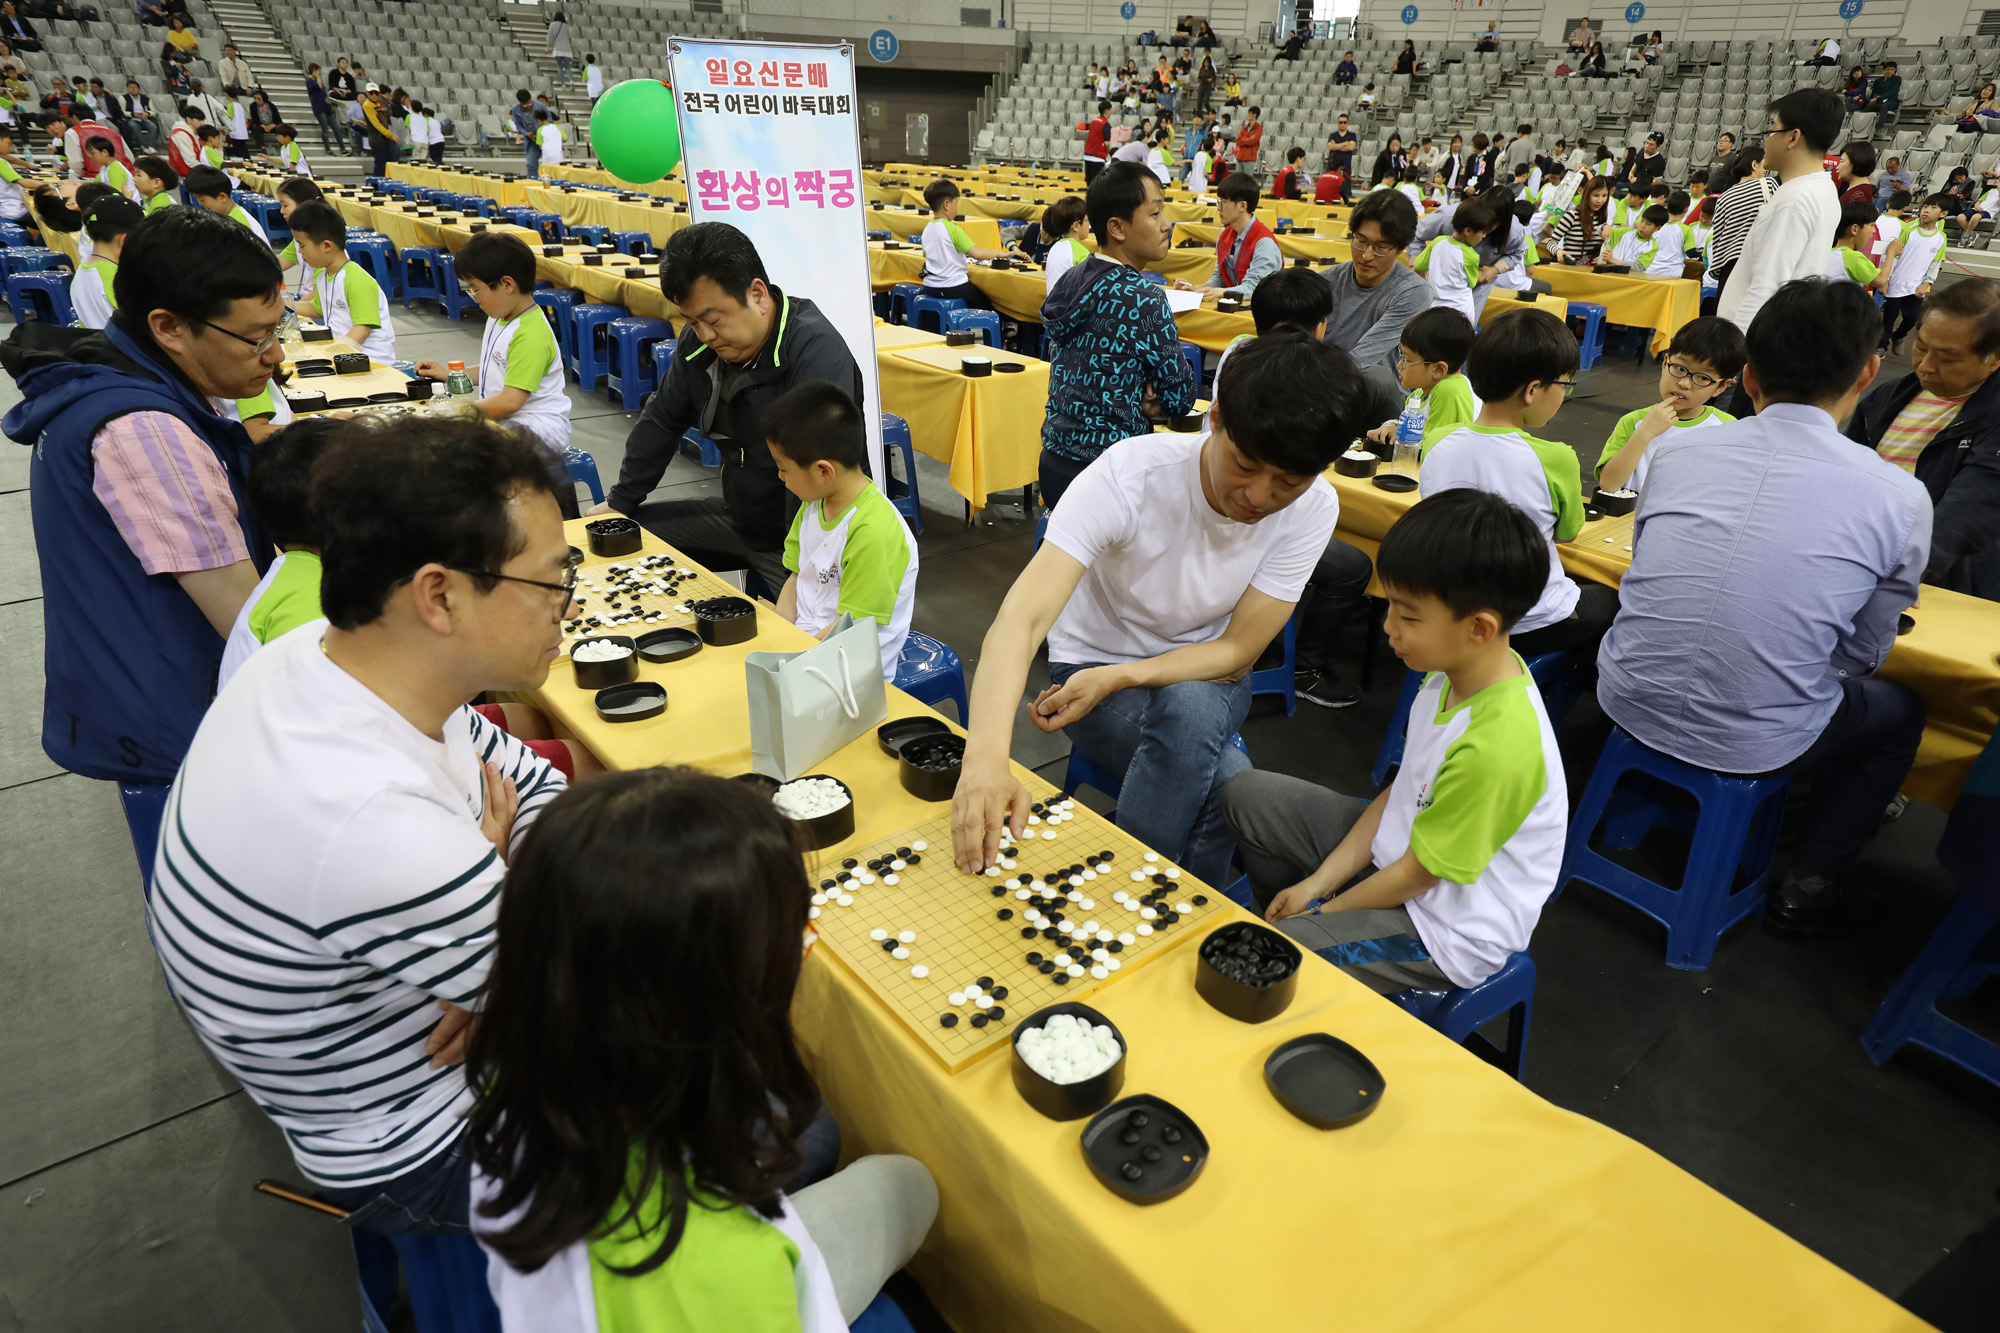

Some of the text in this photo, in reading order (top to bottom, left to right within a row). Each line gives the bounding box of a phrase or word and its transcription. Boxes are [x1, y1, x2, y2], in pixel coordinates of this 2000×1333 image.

[1125, 6, 1133, 14] 12
[1631, 7, 1640, 16] 14
[1847, 1, 1858, 12] 15
[1406, 10, 1414, 18] 13
[875, 36, 892, 51] E1
[705, 58, 829, 88] 일요신문배
[683, 92, 851, 116] 전국 어린이 바둑대회
[696, 169, 856, 212] 환상의 짝궁
